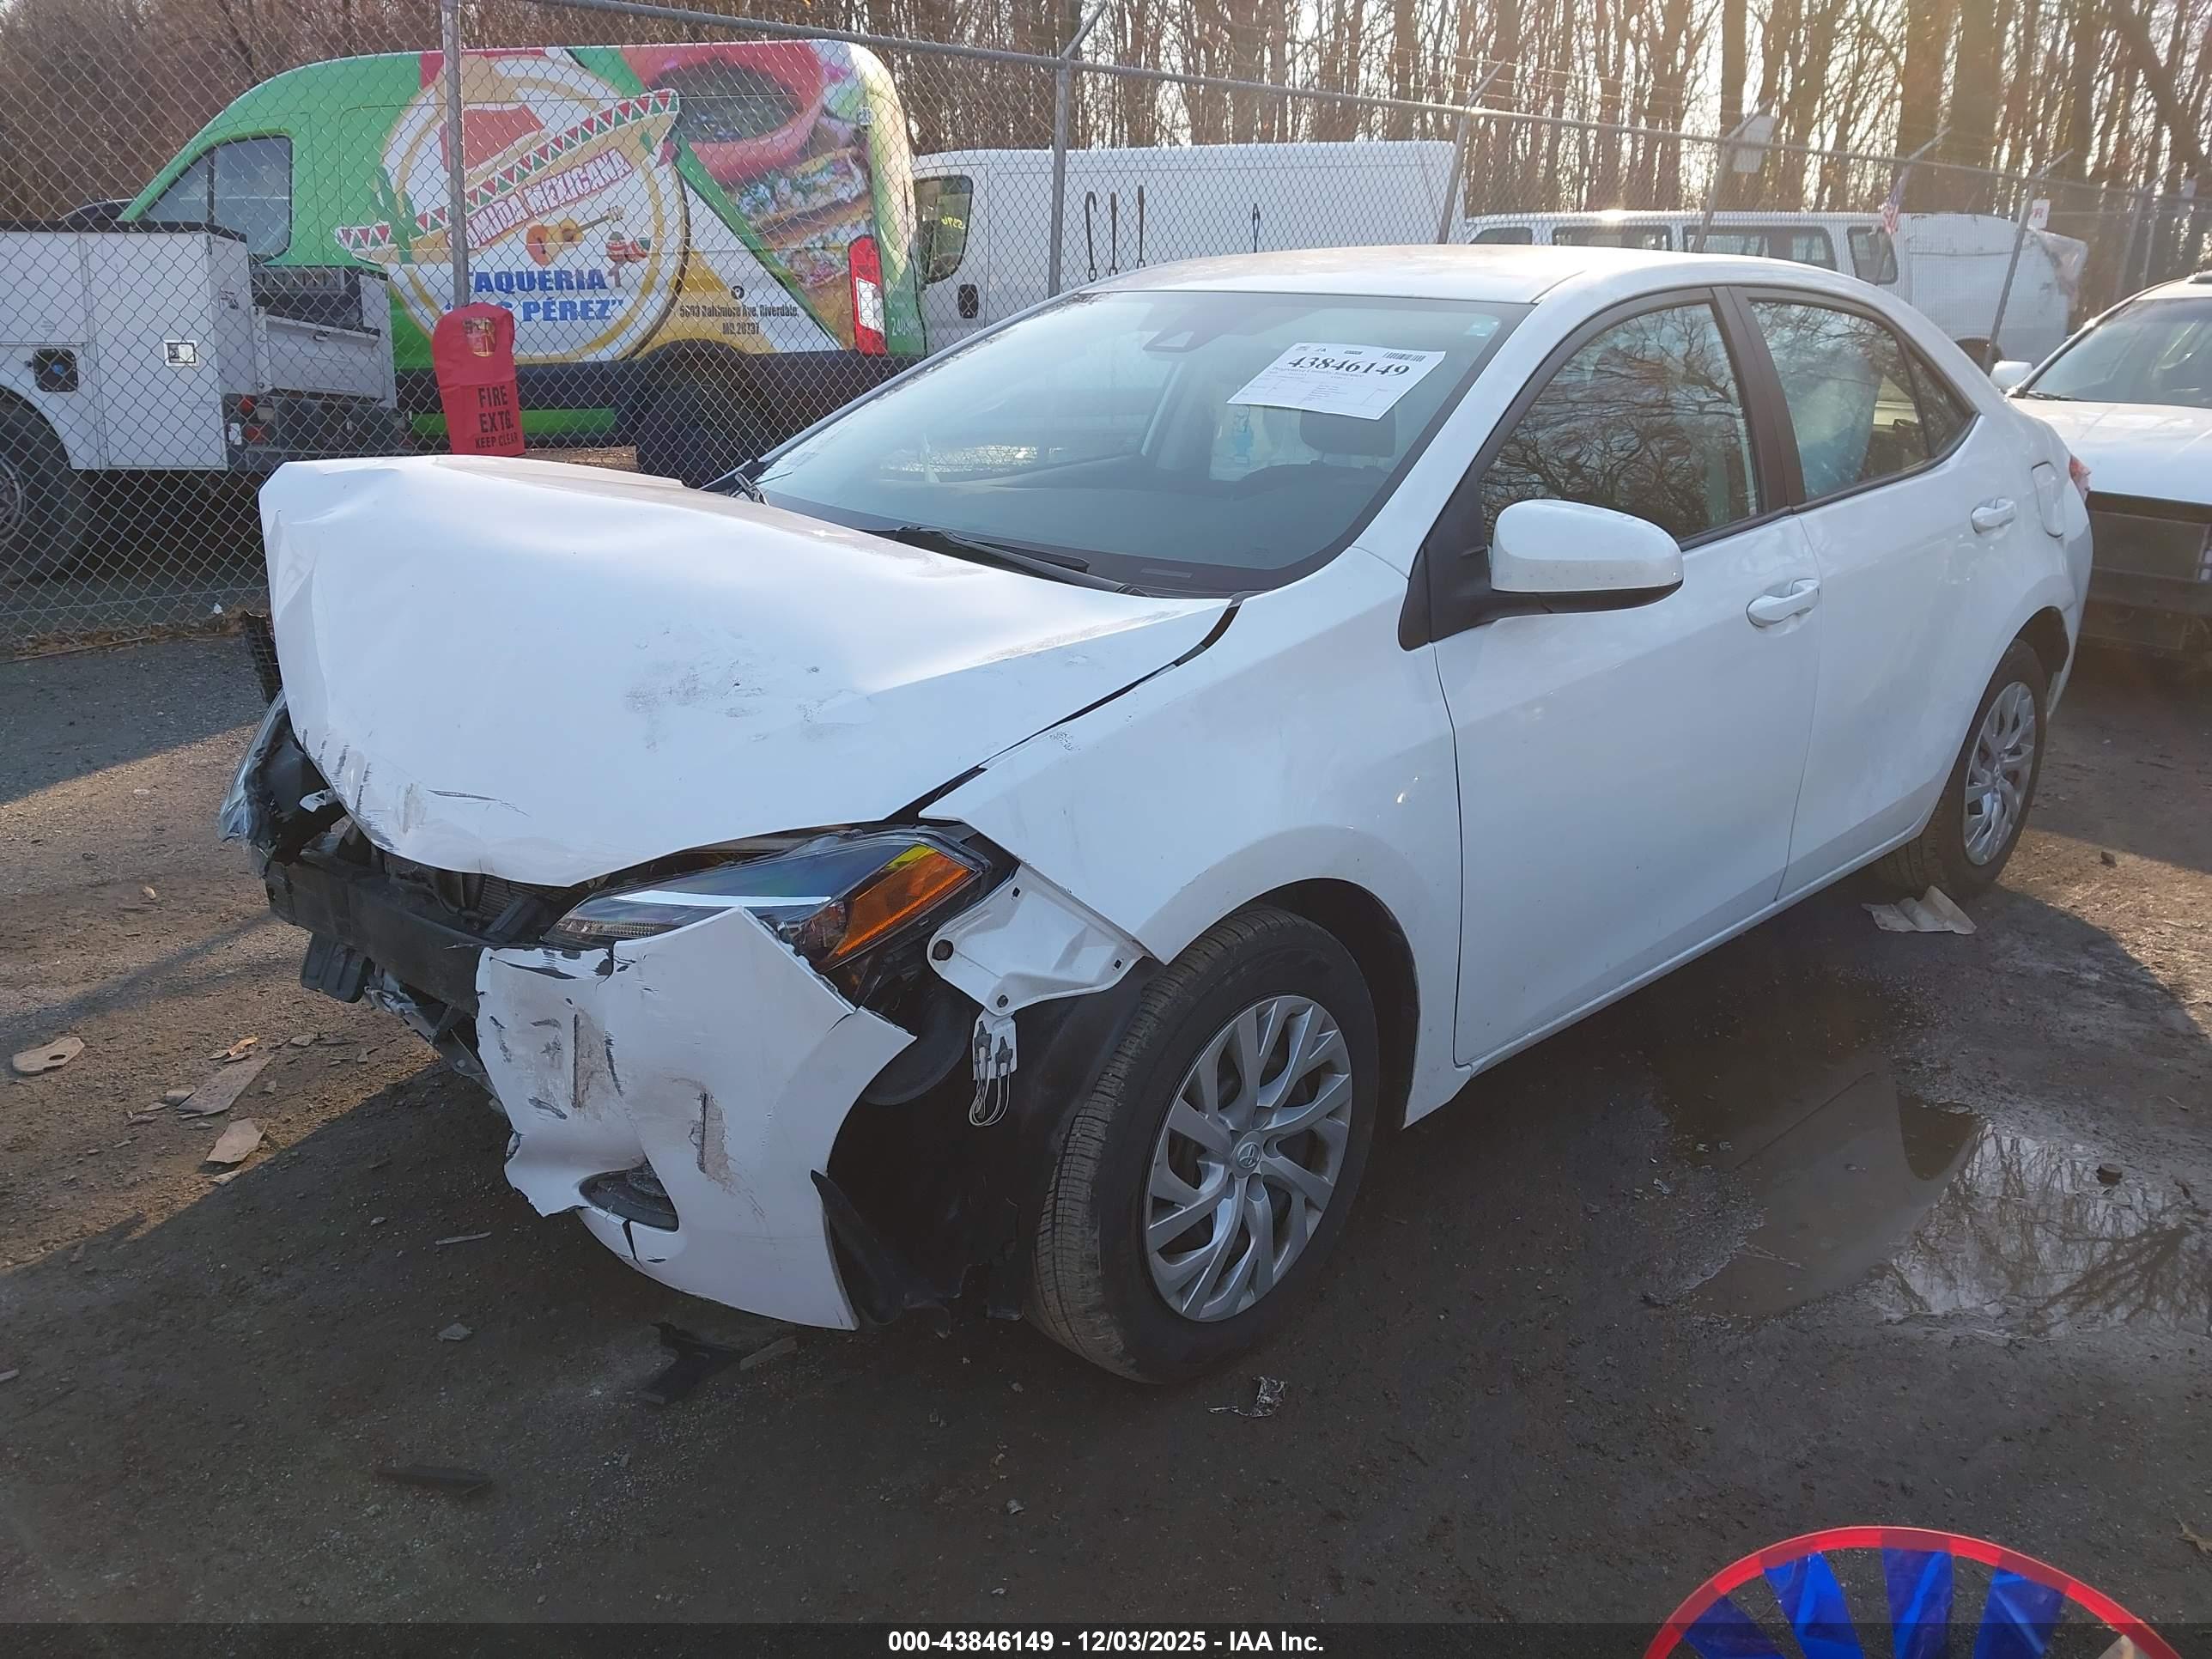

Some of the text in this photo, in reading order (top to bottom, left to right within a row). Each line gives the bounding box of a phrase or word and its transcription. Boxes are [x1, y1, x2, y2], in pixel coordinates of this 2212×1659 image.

[445, 147, 634, 248] OMIDA MEXICANA
[469, 269, 608, 294] AQUERIA
[1287, 356, 1411, 377] 43846149
[477, 386, 508, 408] FIRE
[475, 432, 519, 449] KEEP CLEAR
